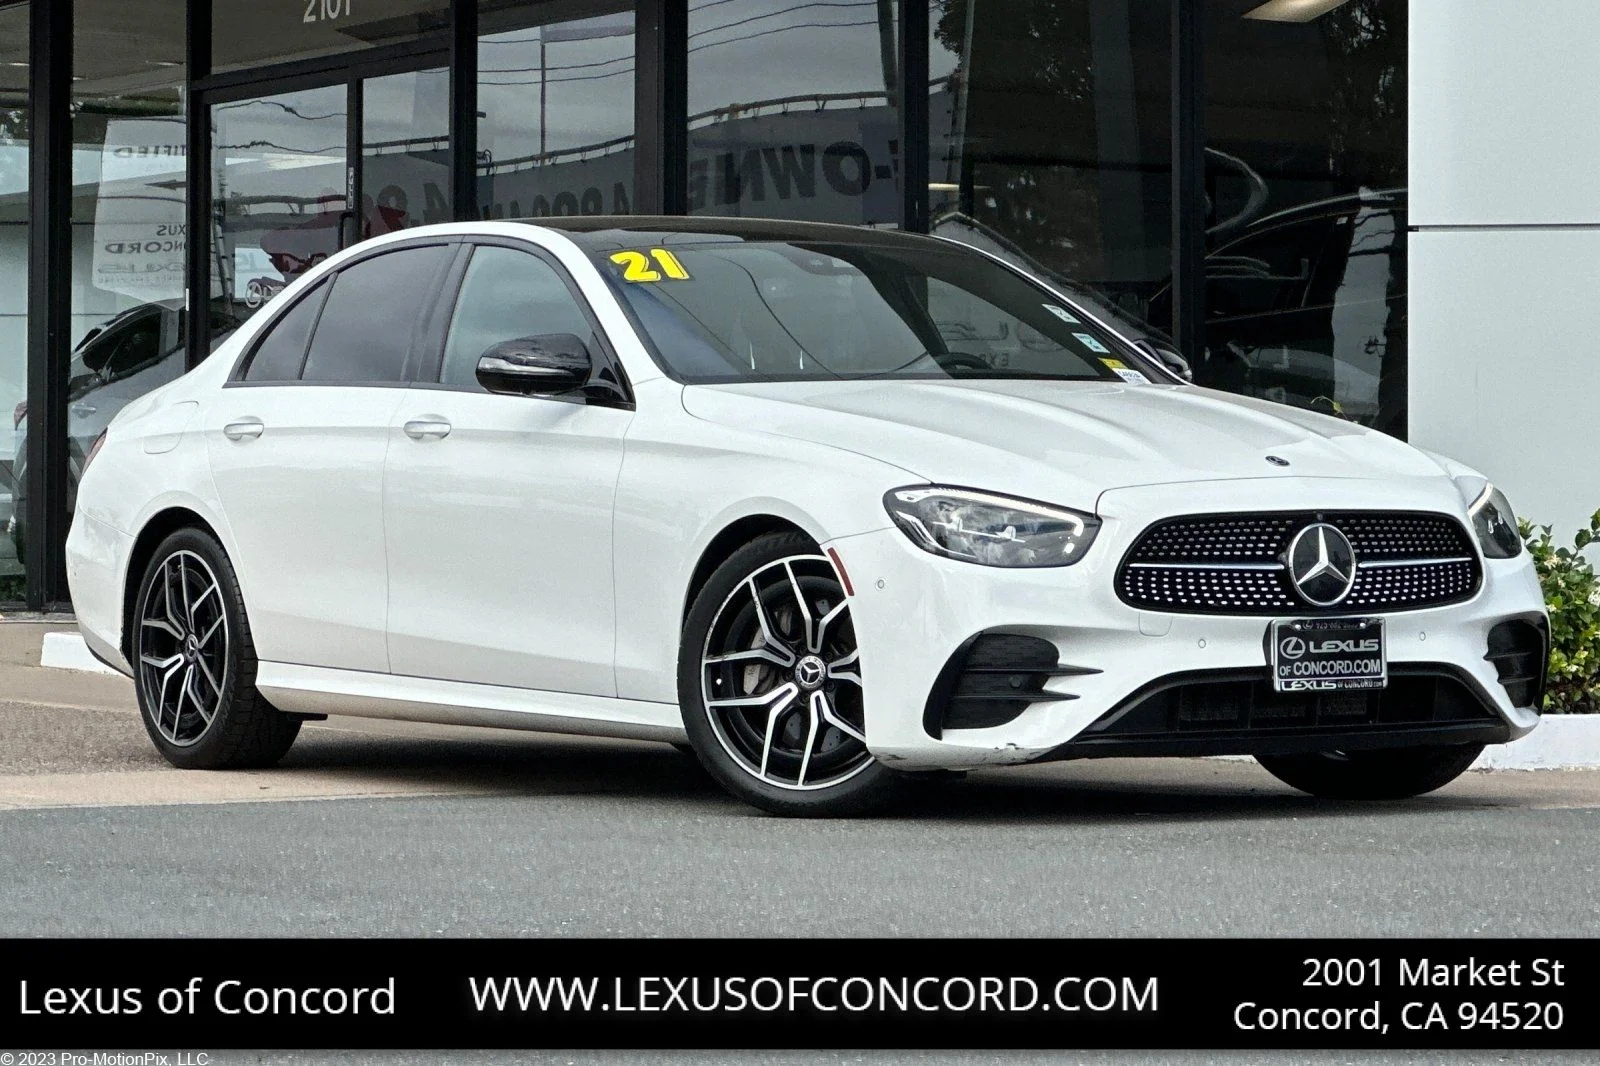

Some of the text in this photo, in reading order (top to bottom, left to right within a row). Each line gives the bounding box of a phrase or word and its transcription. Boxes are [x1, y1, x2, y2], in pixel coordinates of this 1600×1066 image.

[303, 0, 350, 22] 2101
[609, 248, 690, 281] 21
[1309, 639, 1379, 653] LEXUS
[1280, 659, 1381, 676] OF CONCORD.COM
[1281, 680, 1337, 691] LEXUS
